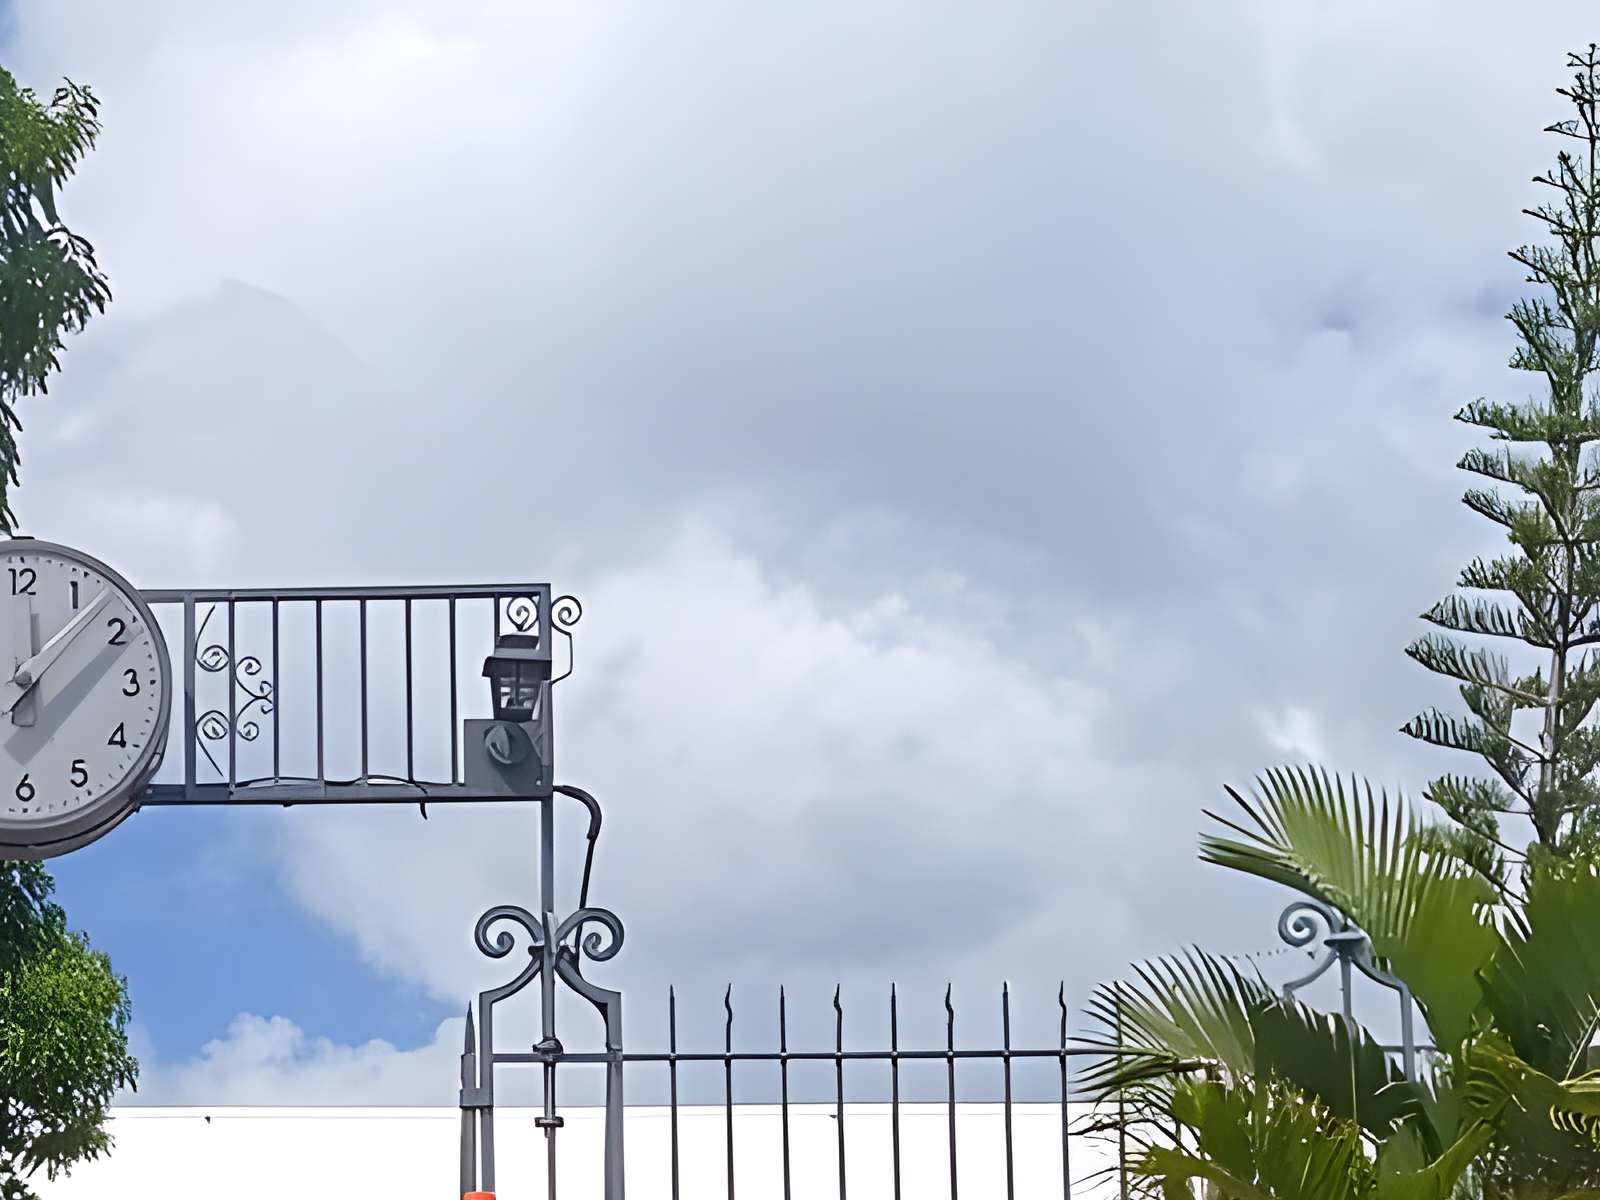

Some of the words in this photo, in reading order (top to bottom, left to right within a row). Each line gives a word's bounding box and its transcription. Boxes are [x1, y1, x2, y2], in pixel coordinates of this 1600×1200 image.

[7, 567, 37, 596] 12
[69, 580, 79, 610] 1
[107, 617, 128, 647] 2
[122, 668, 141, 697] 3
[107, 721, 127, 749] 4
[15, 773, 36, 803] 6
[69, 758, 89, 788] 5
